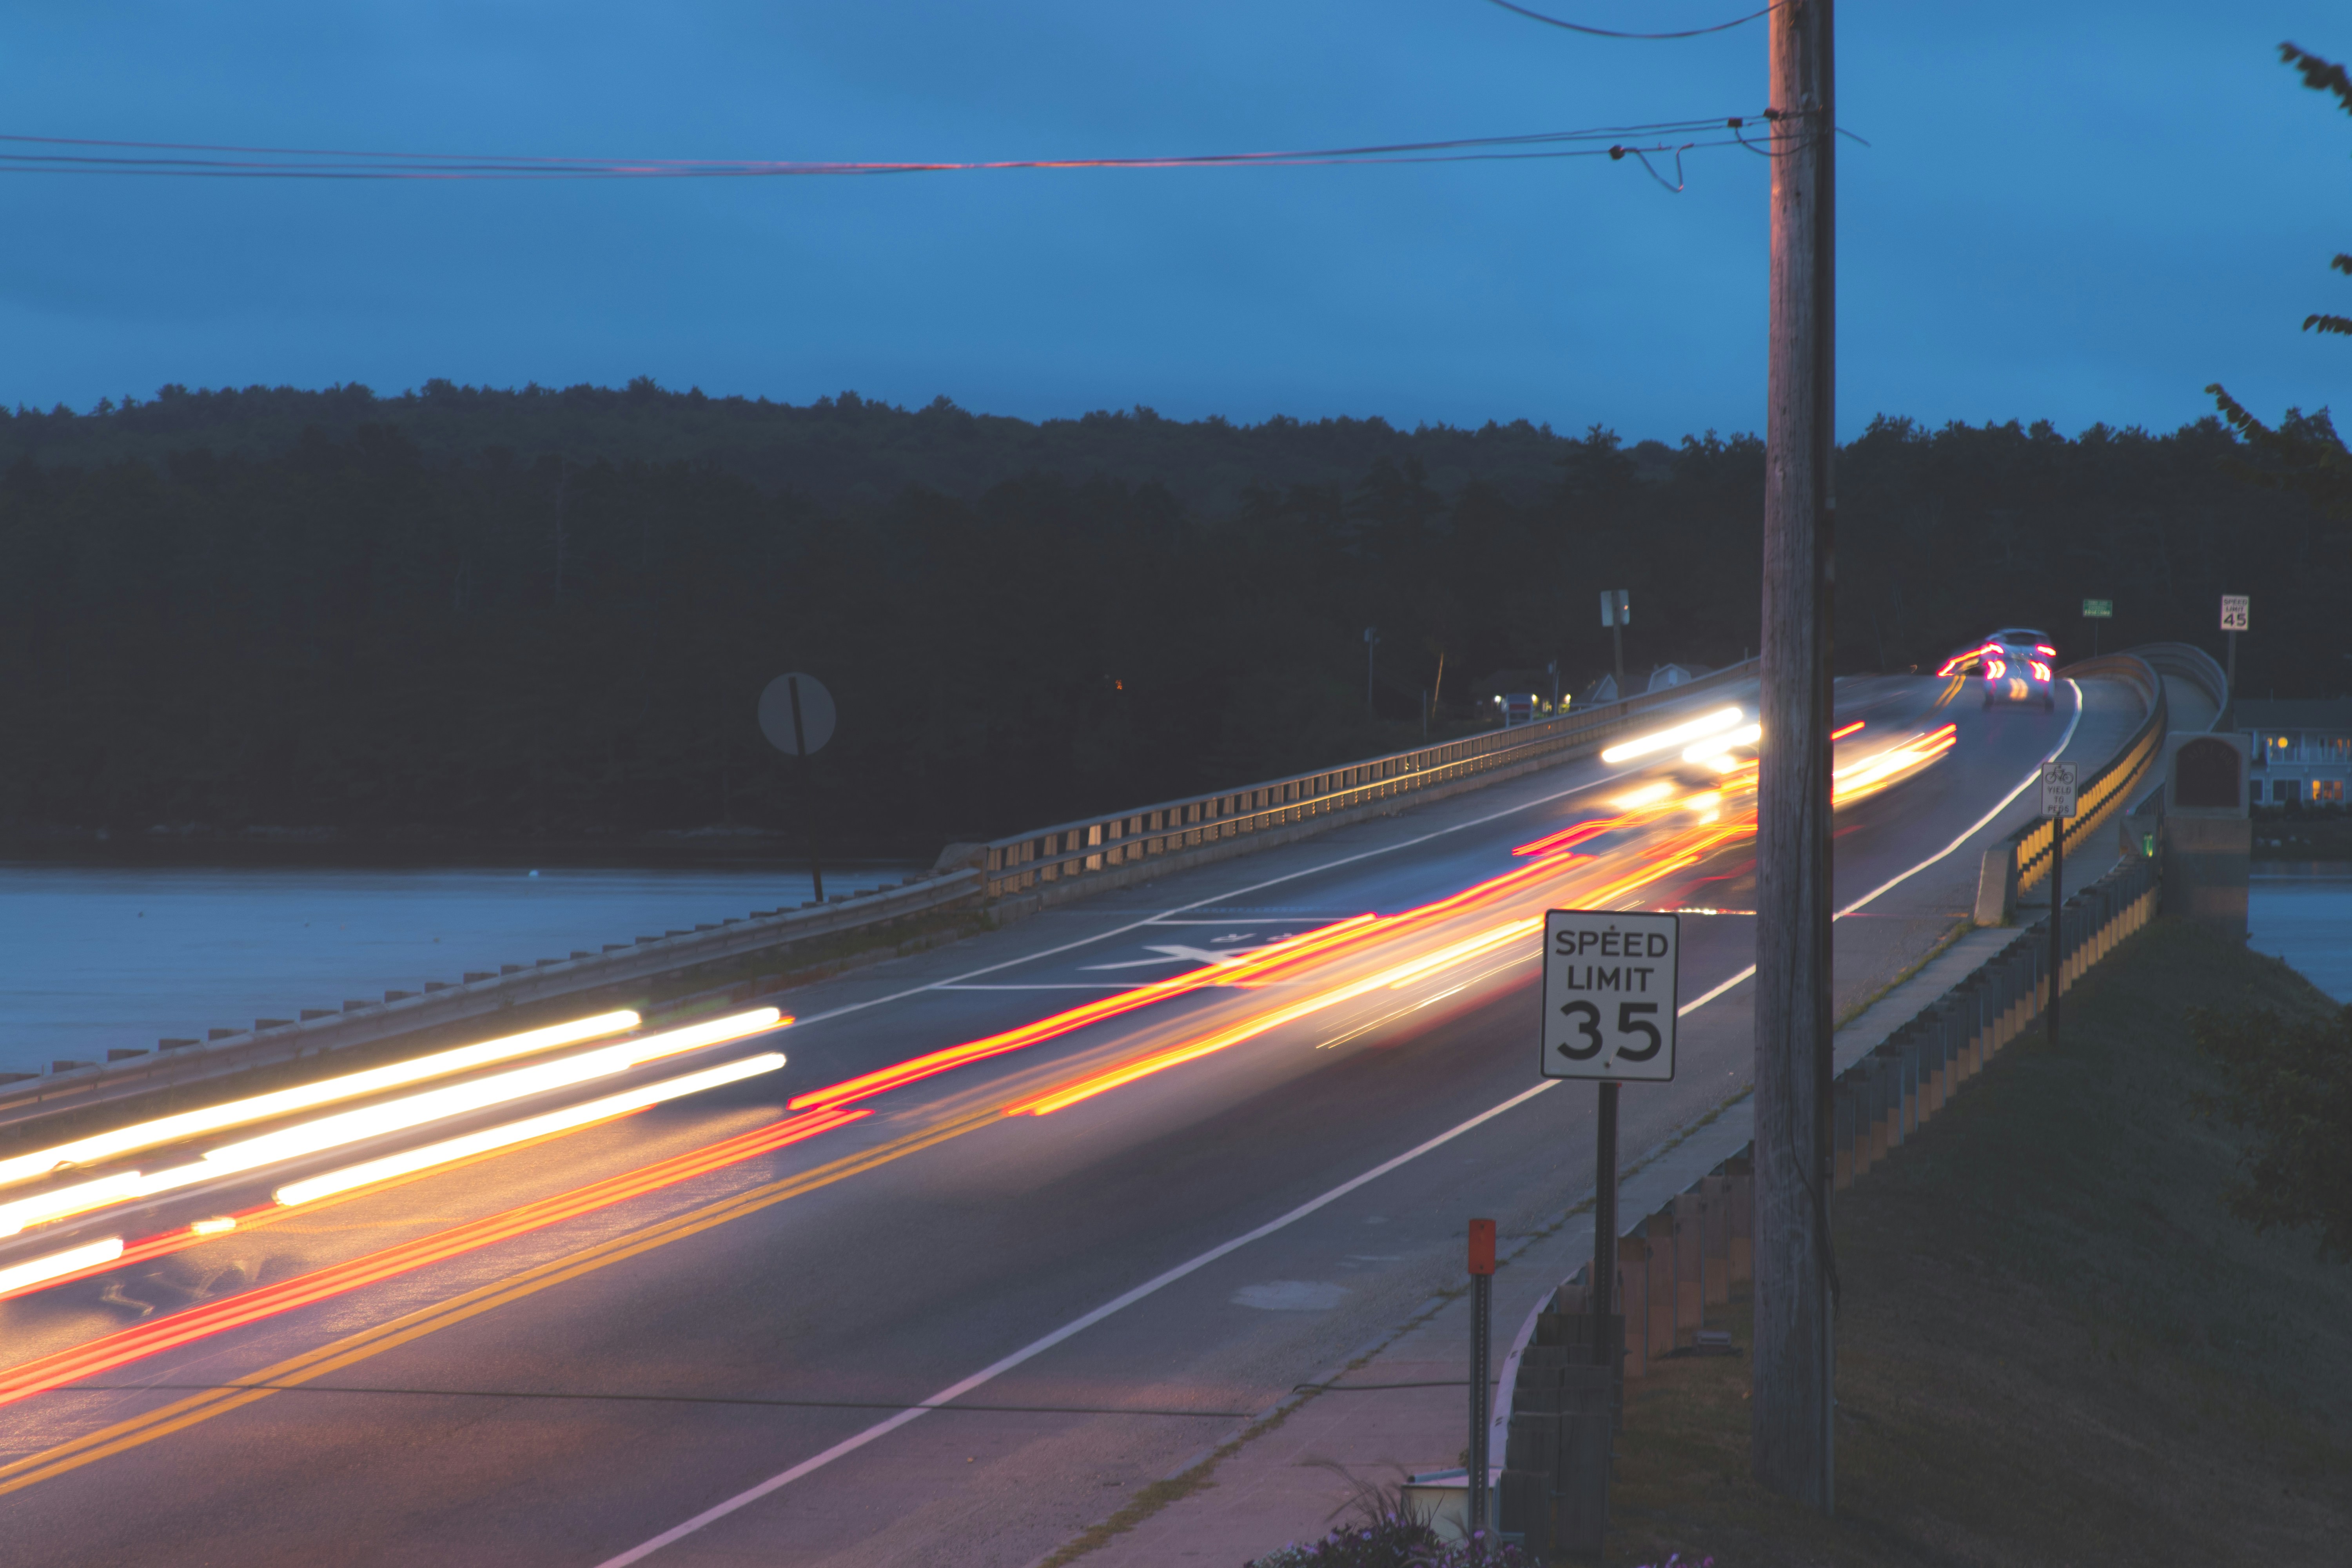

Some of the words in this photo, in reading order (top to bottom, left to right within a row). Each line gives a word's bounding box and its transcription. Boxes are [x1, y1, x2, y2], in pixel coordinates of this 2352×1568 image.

[2223, 613, 2247, 626] 45
[2047, 786, 2071, 795] YIELD
[2054, 796, 2064, 804] TO
[2048, 805, 2069, 813] PEDS
[1555, 929, 1668, 958] SPEED
[1568, 965, 1654, 992] LIMIT
[1557, 1000, 1662, 1062] 35
